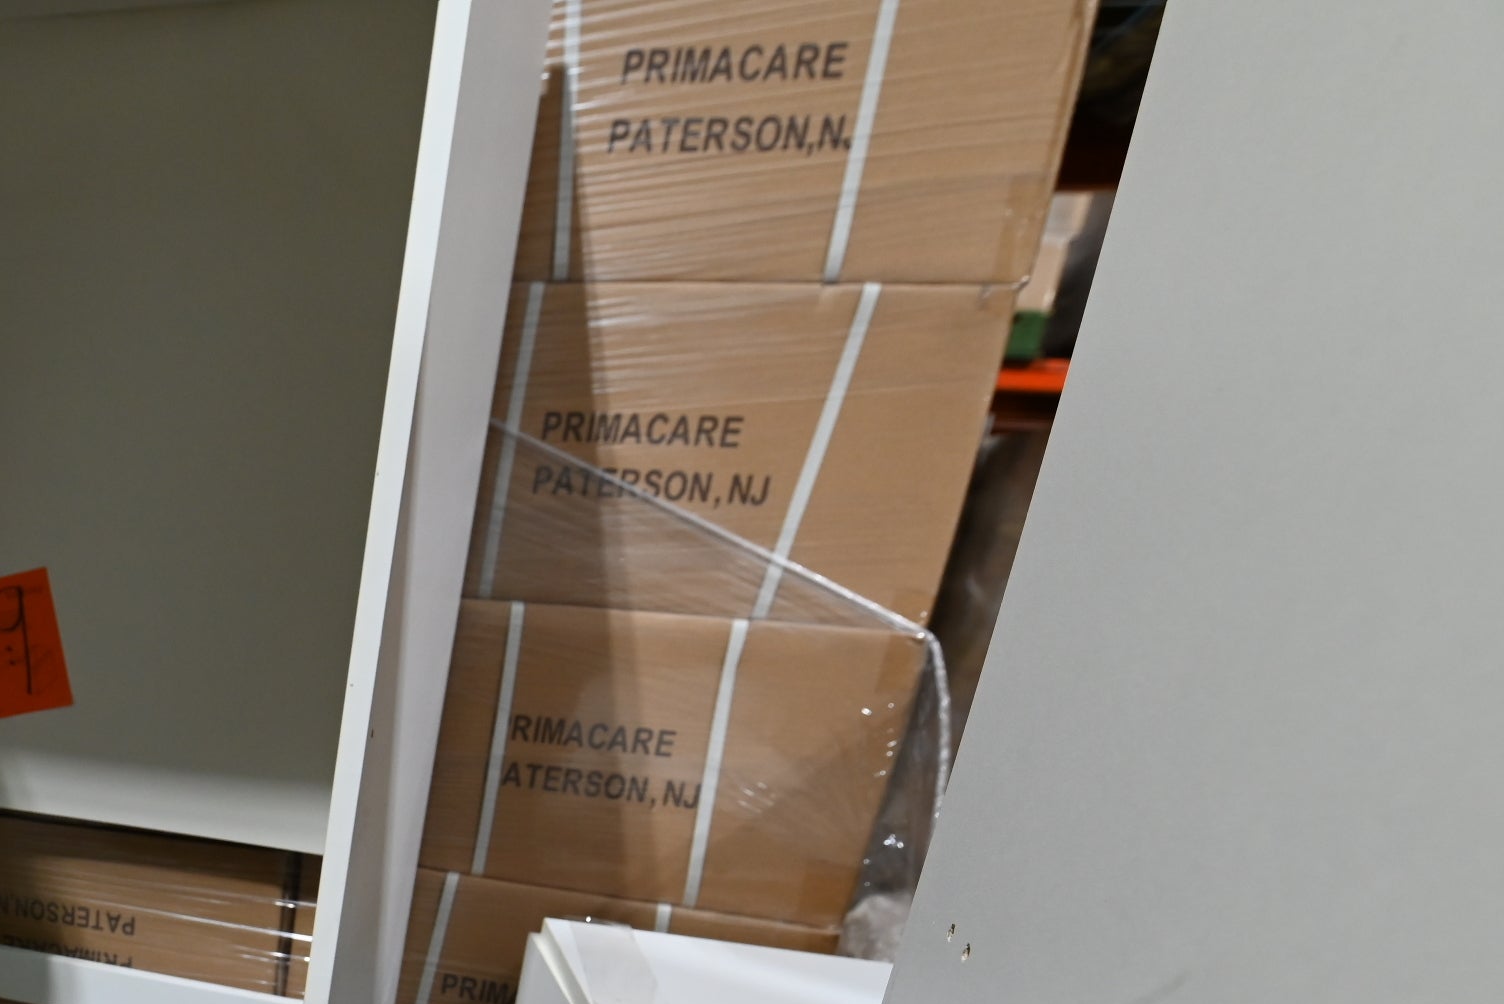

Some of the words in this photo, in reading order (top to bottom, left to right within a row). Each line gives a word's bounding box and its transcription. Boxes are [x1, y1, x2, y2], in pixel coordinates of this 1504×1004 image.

[621, 41, 850, 85] PRIMACARE
[541, 411, 745, 449] PRIMACARE
[508, 714, 677, 758] RIMACARE
